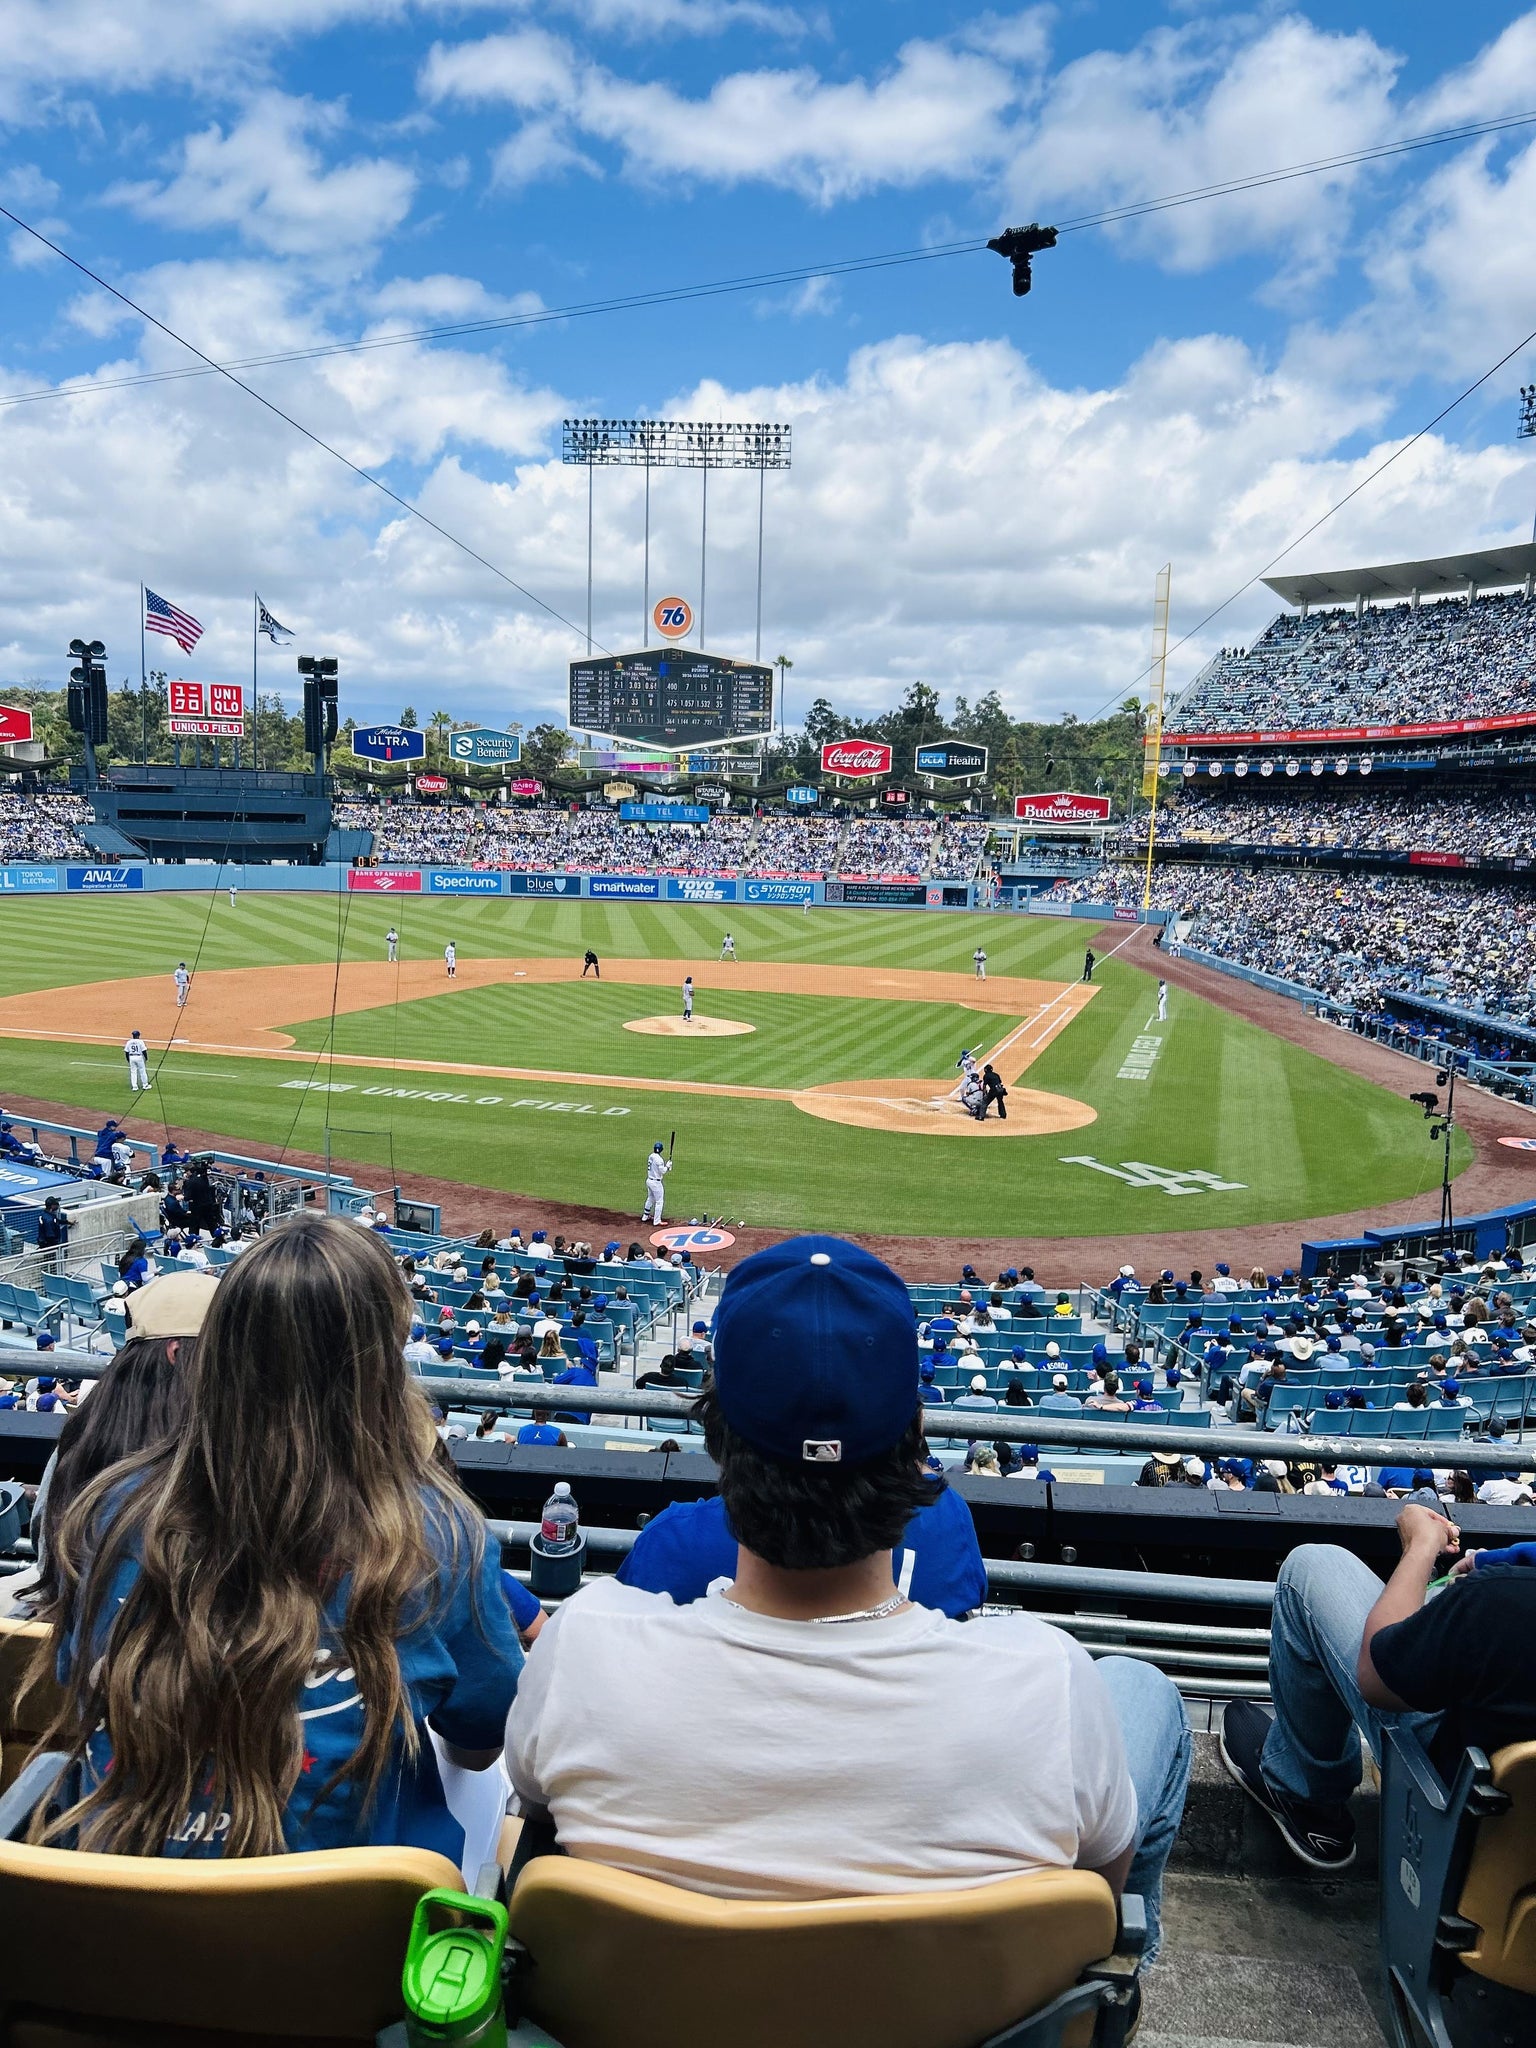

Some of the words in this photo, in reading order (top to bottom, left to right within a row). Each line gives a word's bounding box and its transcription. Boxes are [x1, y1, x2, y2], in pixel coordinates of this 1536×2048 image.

[660, 605, 685, 626] 76
[629, 681, 641, 690] 3.03
[685, 683, 690, 691] 7
[700, 683, 708, 691] 15
[716, 684, 723, 692] 11
[213, 687, 237, 701] UNI
[213, 701, 239, 714] QLO
[631, 698, 639, 706] 33
[680, 699, 695, 708] 1.057
[696, 700, 711, 708] 1.532
[715, 700, 723, 708] 35
[174, 722, 209, 733] UNIQLO
[211, 724, 240, 734] FIELD
[367, 735, 410, 747] ULTRA
[476, 737, 514, 751] Security
[476, 748, 510, 759] Benefit
[920, 755, 944, 765] UCLA
[948, 756, 981, 766] Health
[720, 761, 727, 772] 2
[417, 778, 446, 790] Churu
[791, 789, 814, 801] TEL
[629, 807, 646, 816] TEL
[656, 807, 673, 817] TEL
[683, 808, 700, 818] TEL
[1024, 804, 1100, 819] Budweiser
[22, 877, 56, 885] ELECTRON
[82, 870, 113, 883] ANA
[434, 876, 492, 889] Spectrum
[526, 877, 553, 889] blue
[592, 882, 655, 894] smartwater
[677, 880, 715, 890] TOYO
[682, 889, 724, 900] TIRES
[760, 885, 811, 894] SYNCRON
[930, 893, 939, 901] 76
[1114, 909, 1137, 919] Yakult
[131, 1045, 139, 1053] 91
[360, 1086, 504, 1105] UNIQLO
[509, 1099, 631, 1116] FIELD
[664, 1230, 722, 1248] 76
